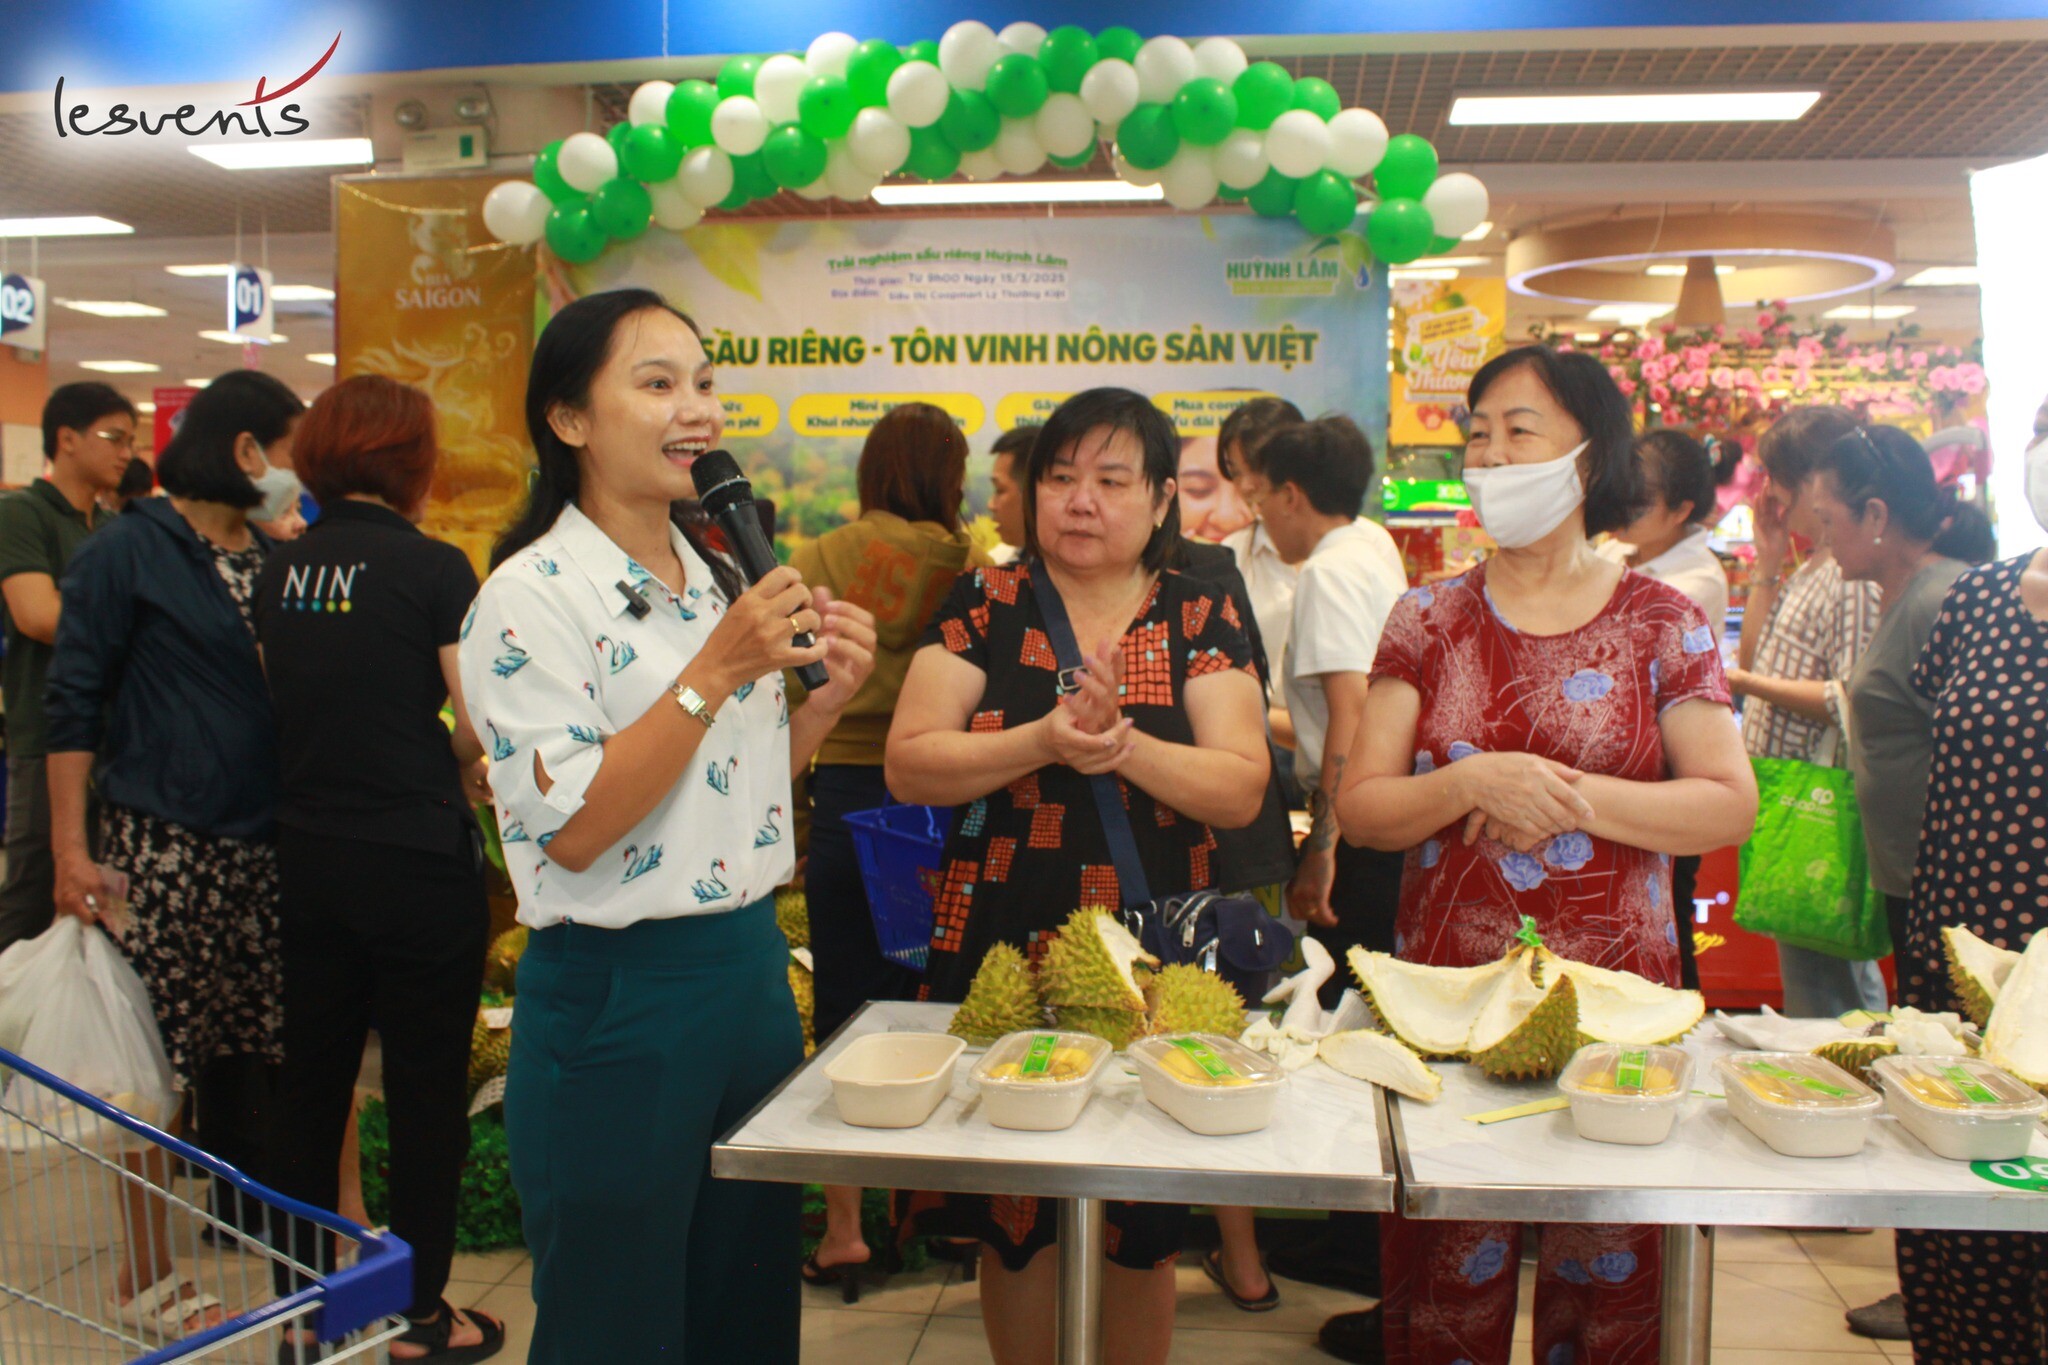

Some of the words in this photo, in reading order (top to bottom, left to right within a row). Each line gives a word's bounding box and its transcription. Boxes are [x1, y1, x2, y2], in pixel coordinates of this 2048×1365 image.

[1227, 256, 1291, 279] HUỲNH
[1297, 257, 1339, 278] LÂM
[1, 285, 33, 324] 02
[237, 277, 261, 315] 01
[395, 287, 482, 310] SAIGON
[768, 328, 865, 364] RIÊNG
[890, 327, 956, 363] TÔN
[964, 335, 1048, 362] VINH
[1057, 325, 1157, 363] NÔNG
[1164, 324, 1234, 362] SẢN
[1243, 325, 1318, 370] VIỆT
[282, 564, 356, 599] NIN
